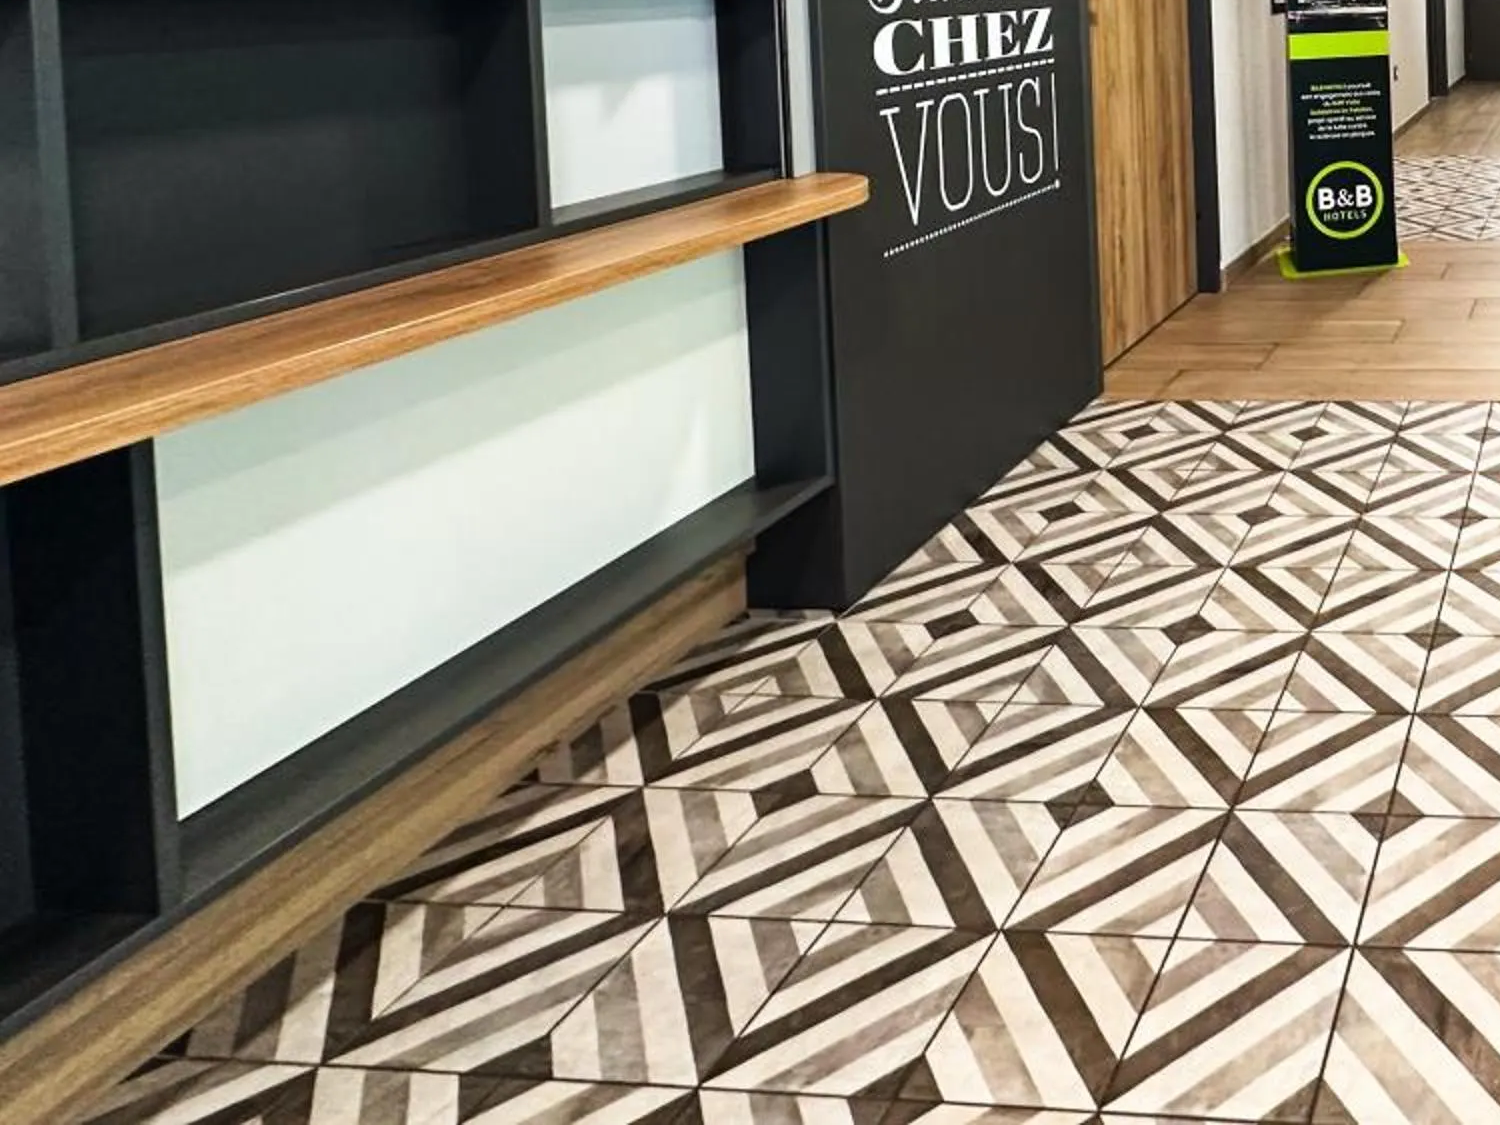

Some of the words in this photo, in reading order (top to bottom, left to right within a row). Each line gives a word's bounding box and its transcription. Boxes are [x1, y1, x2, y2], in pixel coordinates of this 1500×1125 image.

[873, 7, 1054, 75] CHEZ
[879, 72, 1060, 225] VOUS!
[1318, 184, 1373, 211] B&B
[1323, 209, 1367, 222] HOTELS
